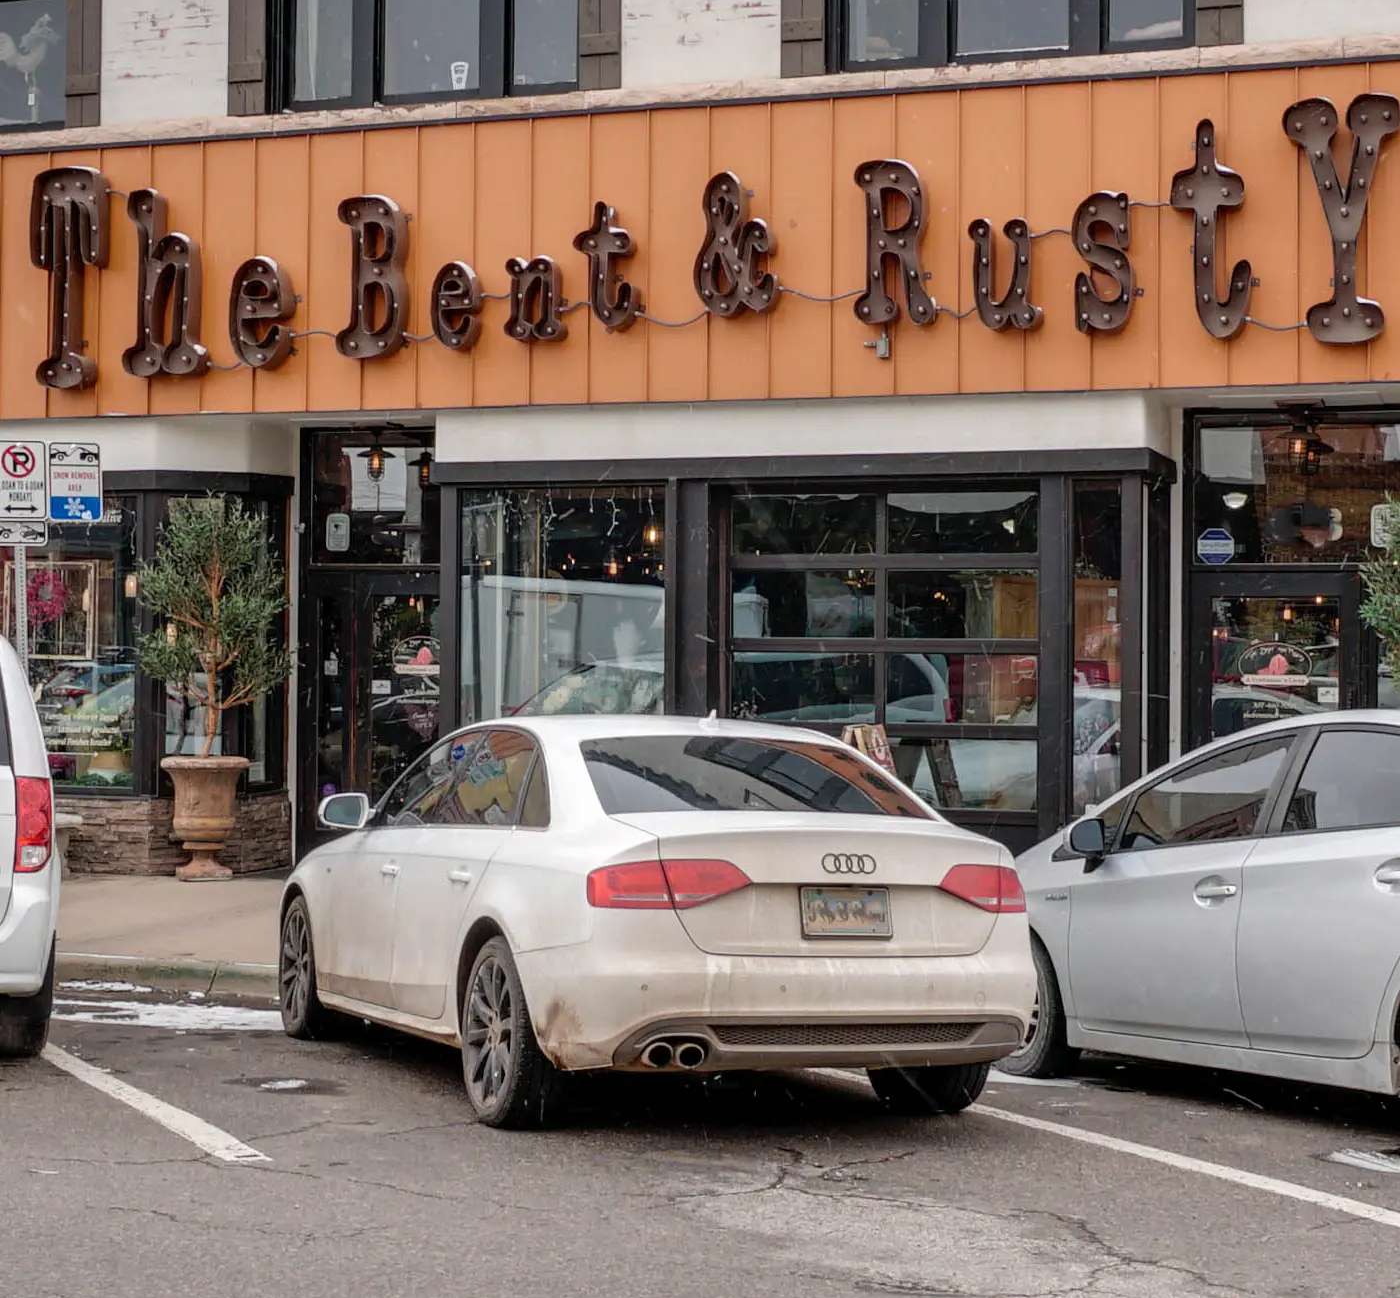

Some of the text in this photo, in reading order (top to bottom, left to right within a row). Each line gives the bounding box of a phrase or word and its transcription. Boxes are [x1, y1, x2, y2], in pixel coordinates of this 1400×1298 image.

[30, 165, 298, 389] The
[335, 193, 639, 359] Bent
[692, 170, 778, 318] &
[53, 471, 96, 480] SNOW REMOVAL
[68, 484, 82, 492] AREA
[9, 491, 33, 502] MONDAYS
